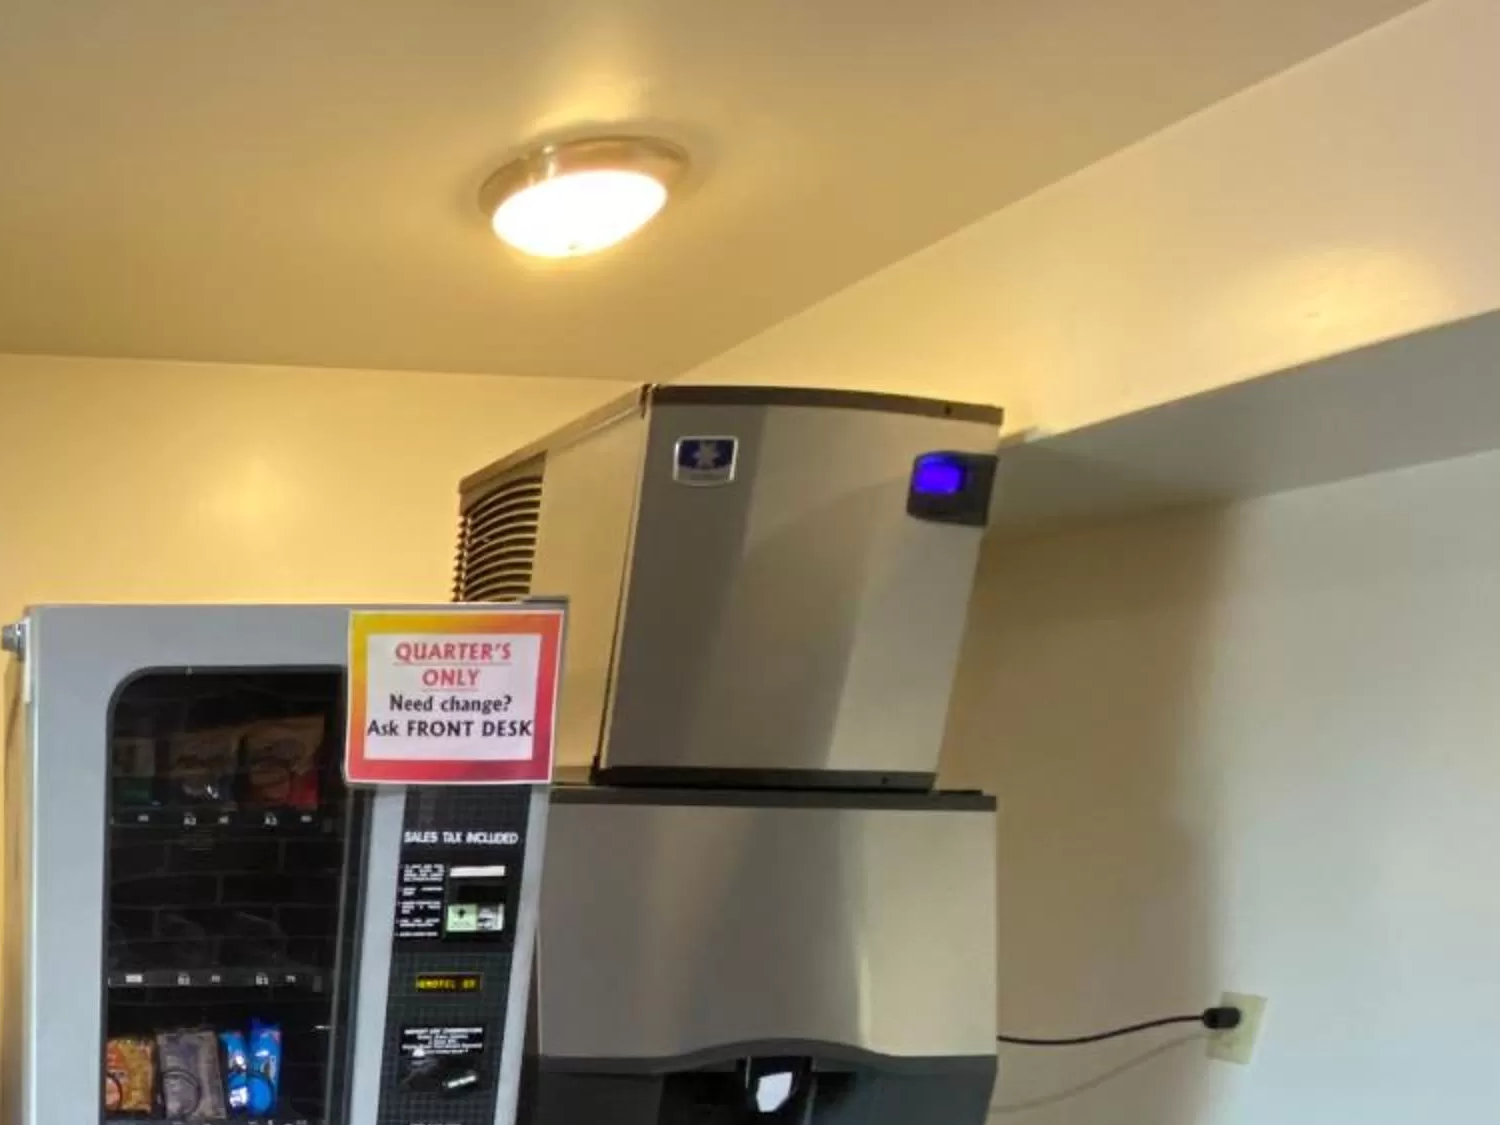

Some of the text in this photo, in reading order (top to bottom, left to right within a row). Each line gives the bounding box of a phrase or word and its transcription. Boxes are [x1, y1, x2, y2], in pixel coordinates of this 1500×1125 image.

[394, 642, 512, 661] QUARTER'S
[422, 668, 480, 686] ONLY
[389, 694, 513, 714] Need change?
[367, 720, 533, 736] Ask FRONT DESK
[404, 831, 519, 844] SALES TAX INCLUDED
